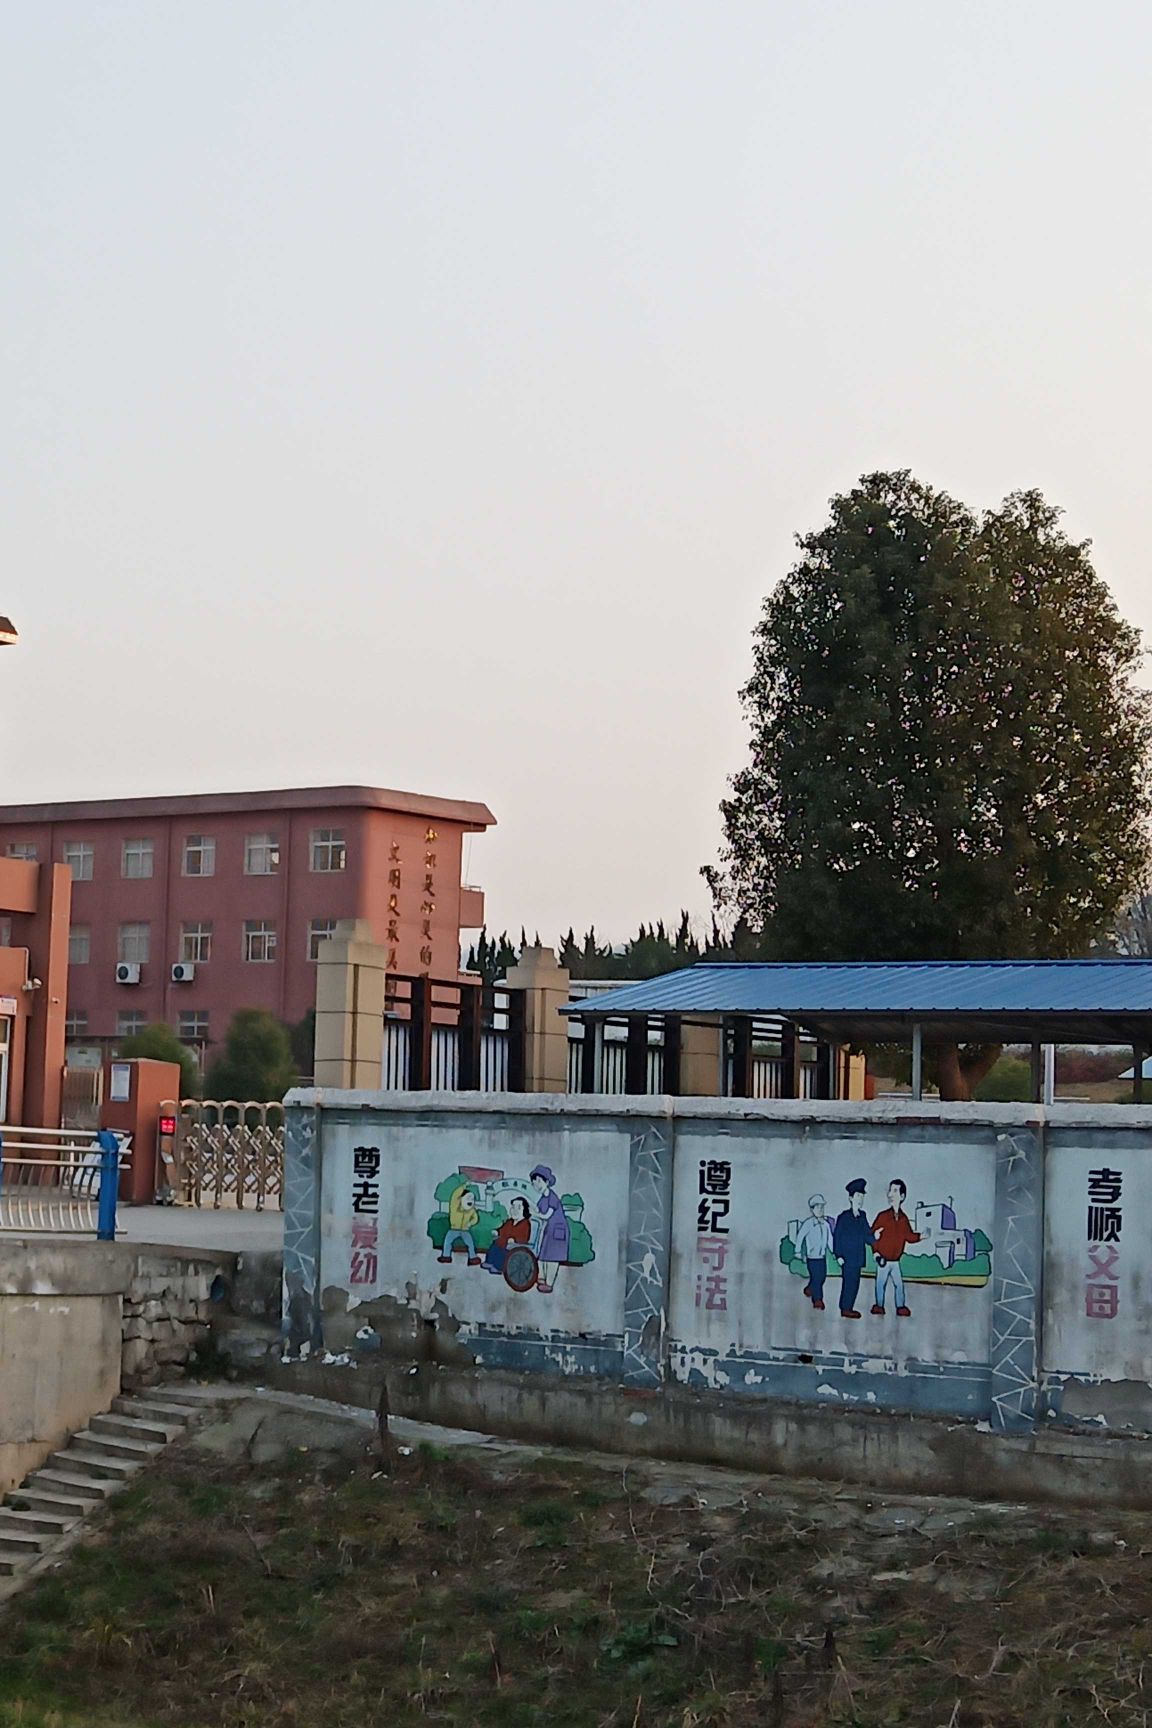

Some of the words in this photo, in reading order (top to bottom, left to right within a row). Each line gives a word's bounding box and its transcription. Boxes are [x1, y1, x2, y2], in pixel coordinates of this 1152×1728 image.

[350, 1146, 380, 1285] 尊老爱幼
[695, 1160, 732, 1311] 遵纪守法
[1085, 1168, 1123, 1320] 孝顺父母
